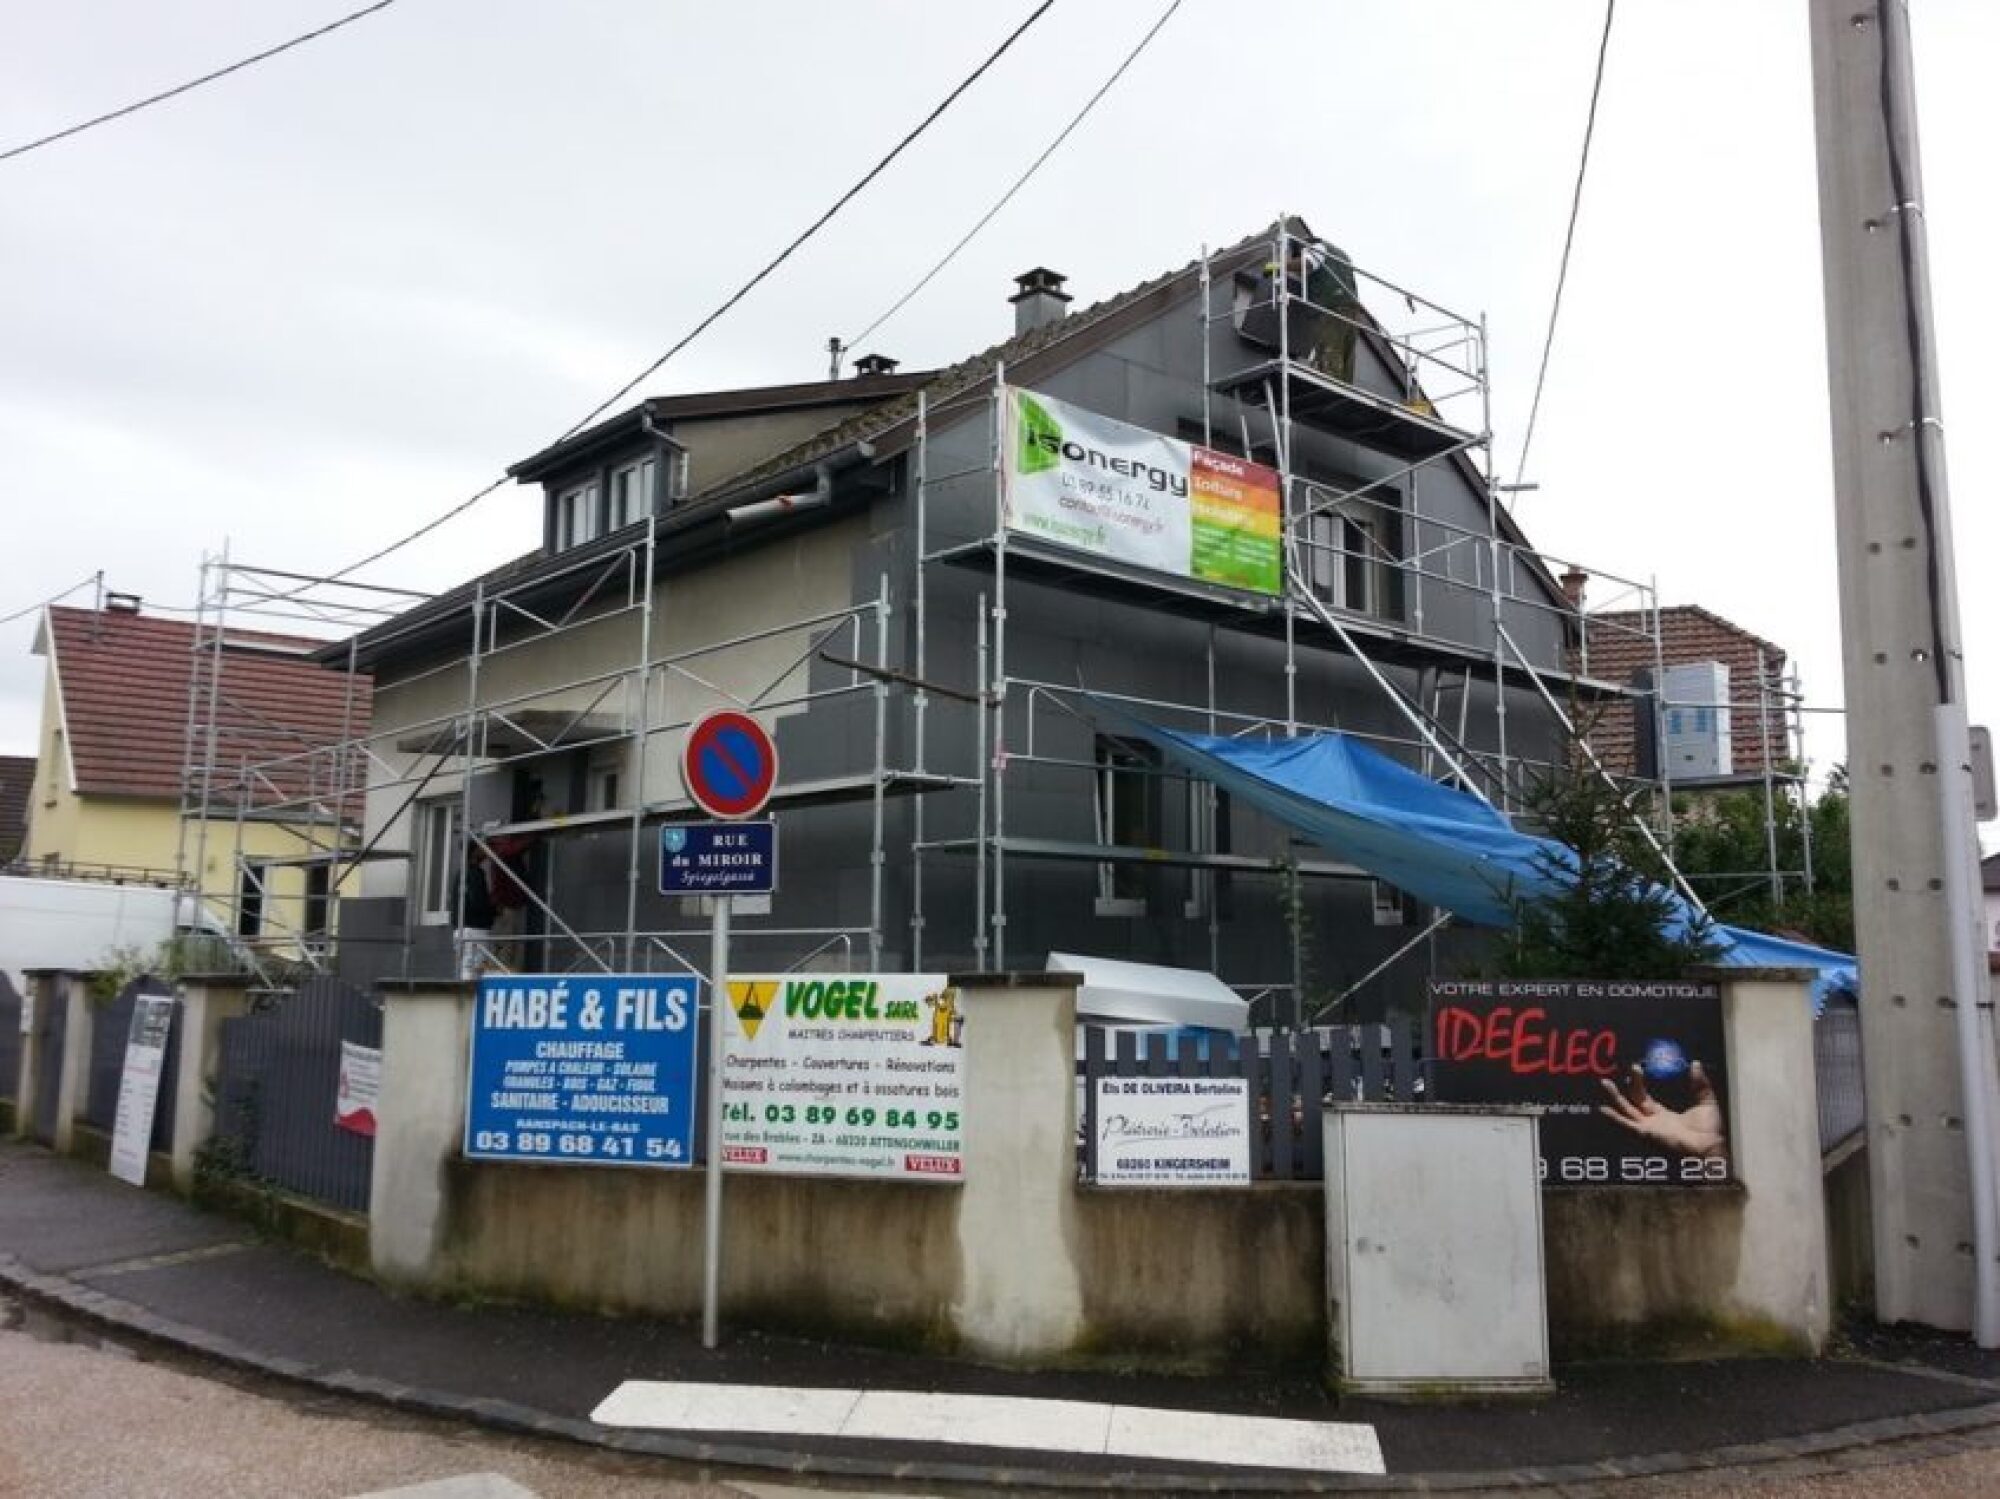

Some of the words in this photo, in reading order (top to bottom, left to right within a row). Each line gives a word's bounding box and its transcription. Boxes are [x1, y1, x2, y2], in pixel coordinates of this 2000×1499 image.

[1027, 425, 1190, 498] isonergy
[712, 834, 749, 846] RUE
[672, 856, 690, 867] du
[698, 854, 763, 866] MIROIR
[785, 981, 881, 1020] VOGEL
[1430, 983, 1493, 997] VOTRE
[1499, 983, 1570, 997] EXPERT
[1577, 983, 1603, 997] EN
[1608, 983, 1718, 998] DOMOTIQUE
[483, 979, 570, 1030] HABÉ
[579, 988, 605, 1030] &
[615, 988, 689, 1031] FILS
[535, 1041, 624, 1059] CHAUFFAGE
[726, 1054, 787, 1072] Charpentes
[803, 1055, 870, 1072] Couvertures
[885, 1056, 955, 1074] Rénovations
[847, 1082, 859, 1094] et
[863, 1081, 871, 1095] à
[934, 1083, 960, 1098] bois
[1123, 1082, 1138, 1094] DE
[1142, 1082, 1191, 1094] OLIVEIRA
[491, 1093, 559, 1110] SANITAIRE
[571, 1095, 669, 1113] ADOUCISSEUR
[764, 1104, 796, 1123] 03
[805, 1105, 837, 1125] 89
[845, 1107, 877, 1127] 69
[885, 1108, 917, 1129] 84
[927, 1111, 960, 1131] 95
[476, 1130, 509, 1150] 03
[517, 1132, 551, 1152] 89
[559, 1134, 594, 1154] 68
[602, 1136, 634, 1156] 41
[646, 1138, 681, 1158] 54
[1154, 1158, 1231, 1169] KINGERSHEIM
[1560, 1156, 1609, 1181] 68
[1621, 1156, 1668, 1181] 52
[1680, 1156, 1727, 1181] 23
